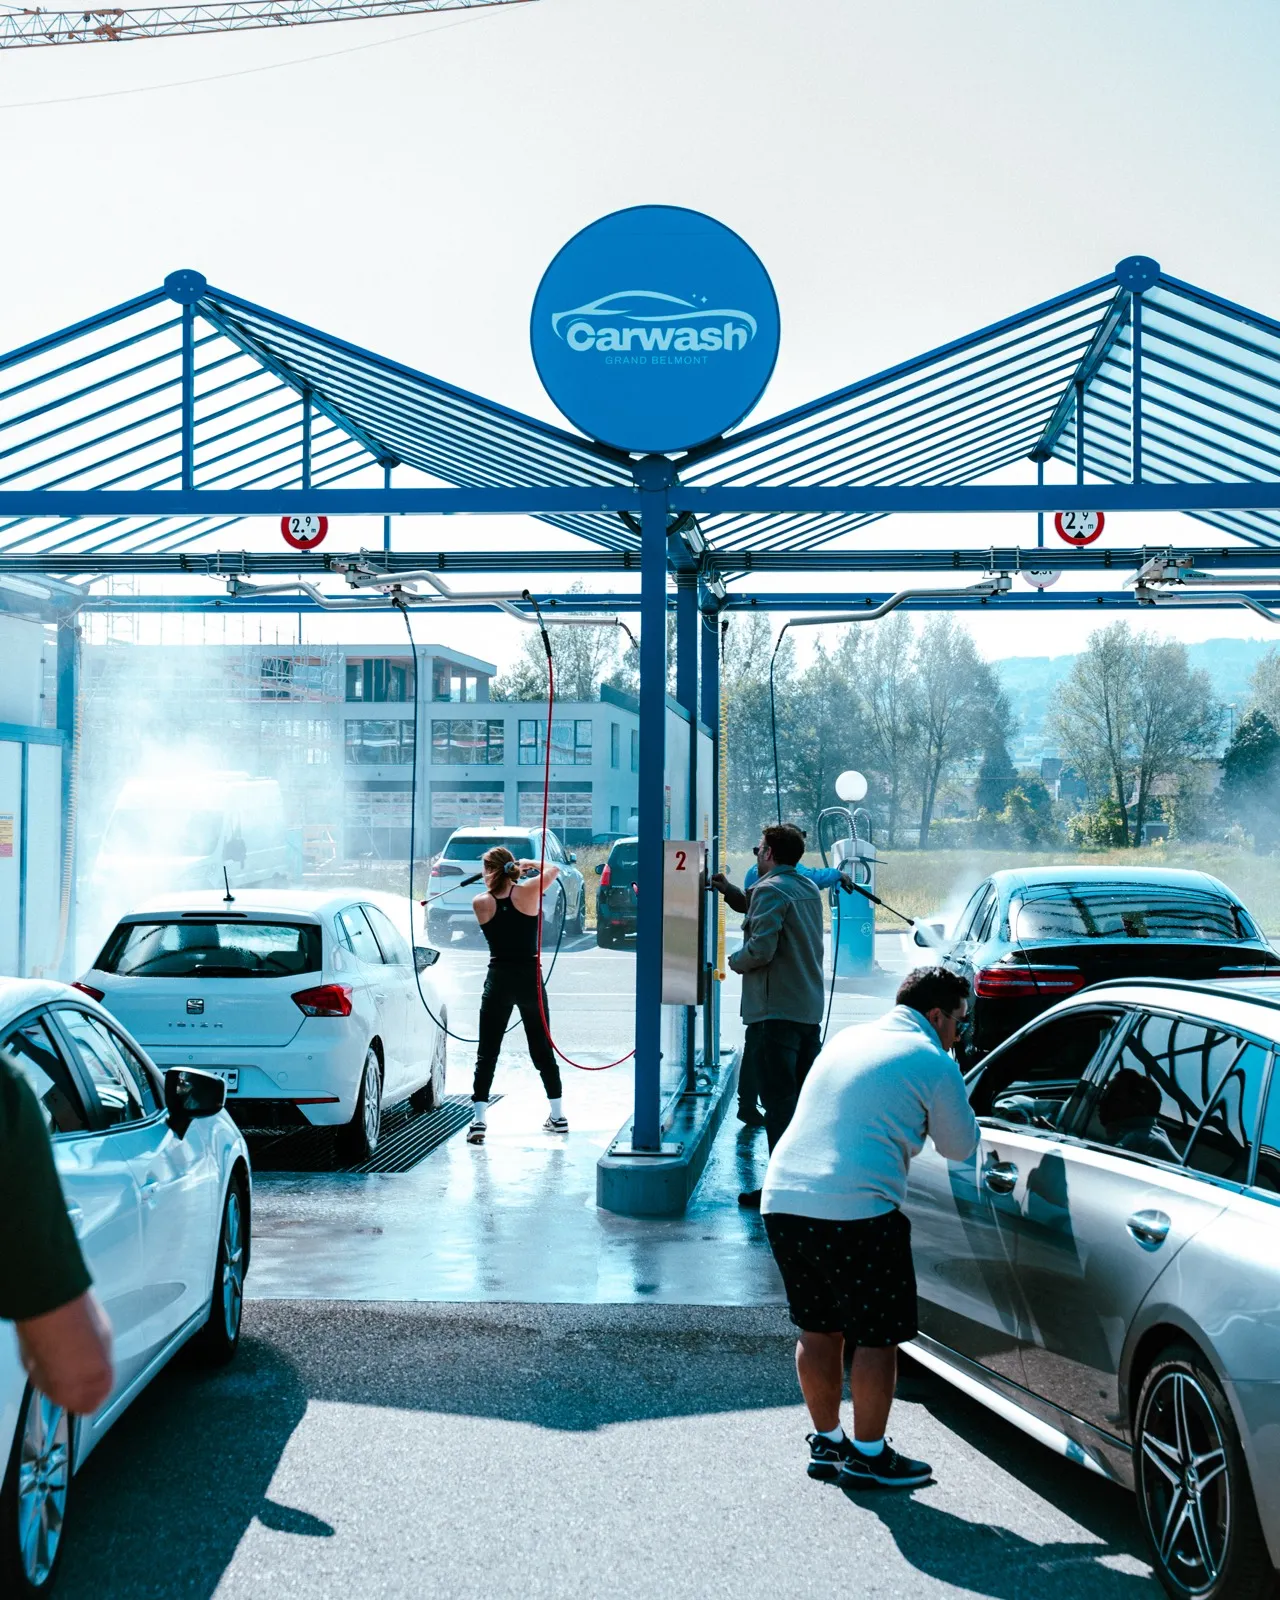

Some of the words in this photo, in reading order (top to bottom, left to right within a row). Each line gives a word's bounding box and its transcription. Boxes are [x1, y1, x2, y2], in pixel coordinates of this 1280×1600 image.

[566, 321, 748, 352] Carwash
[605, 356, 647, 365] GRAND
[651, 356, 708, 365] BELMONT
[675, 851, 687, 871] 2
